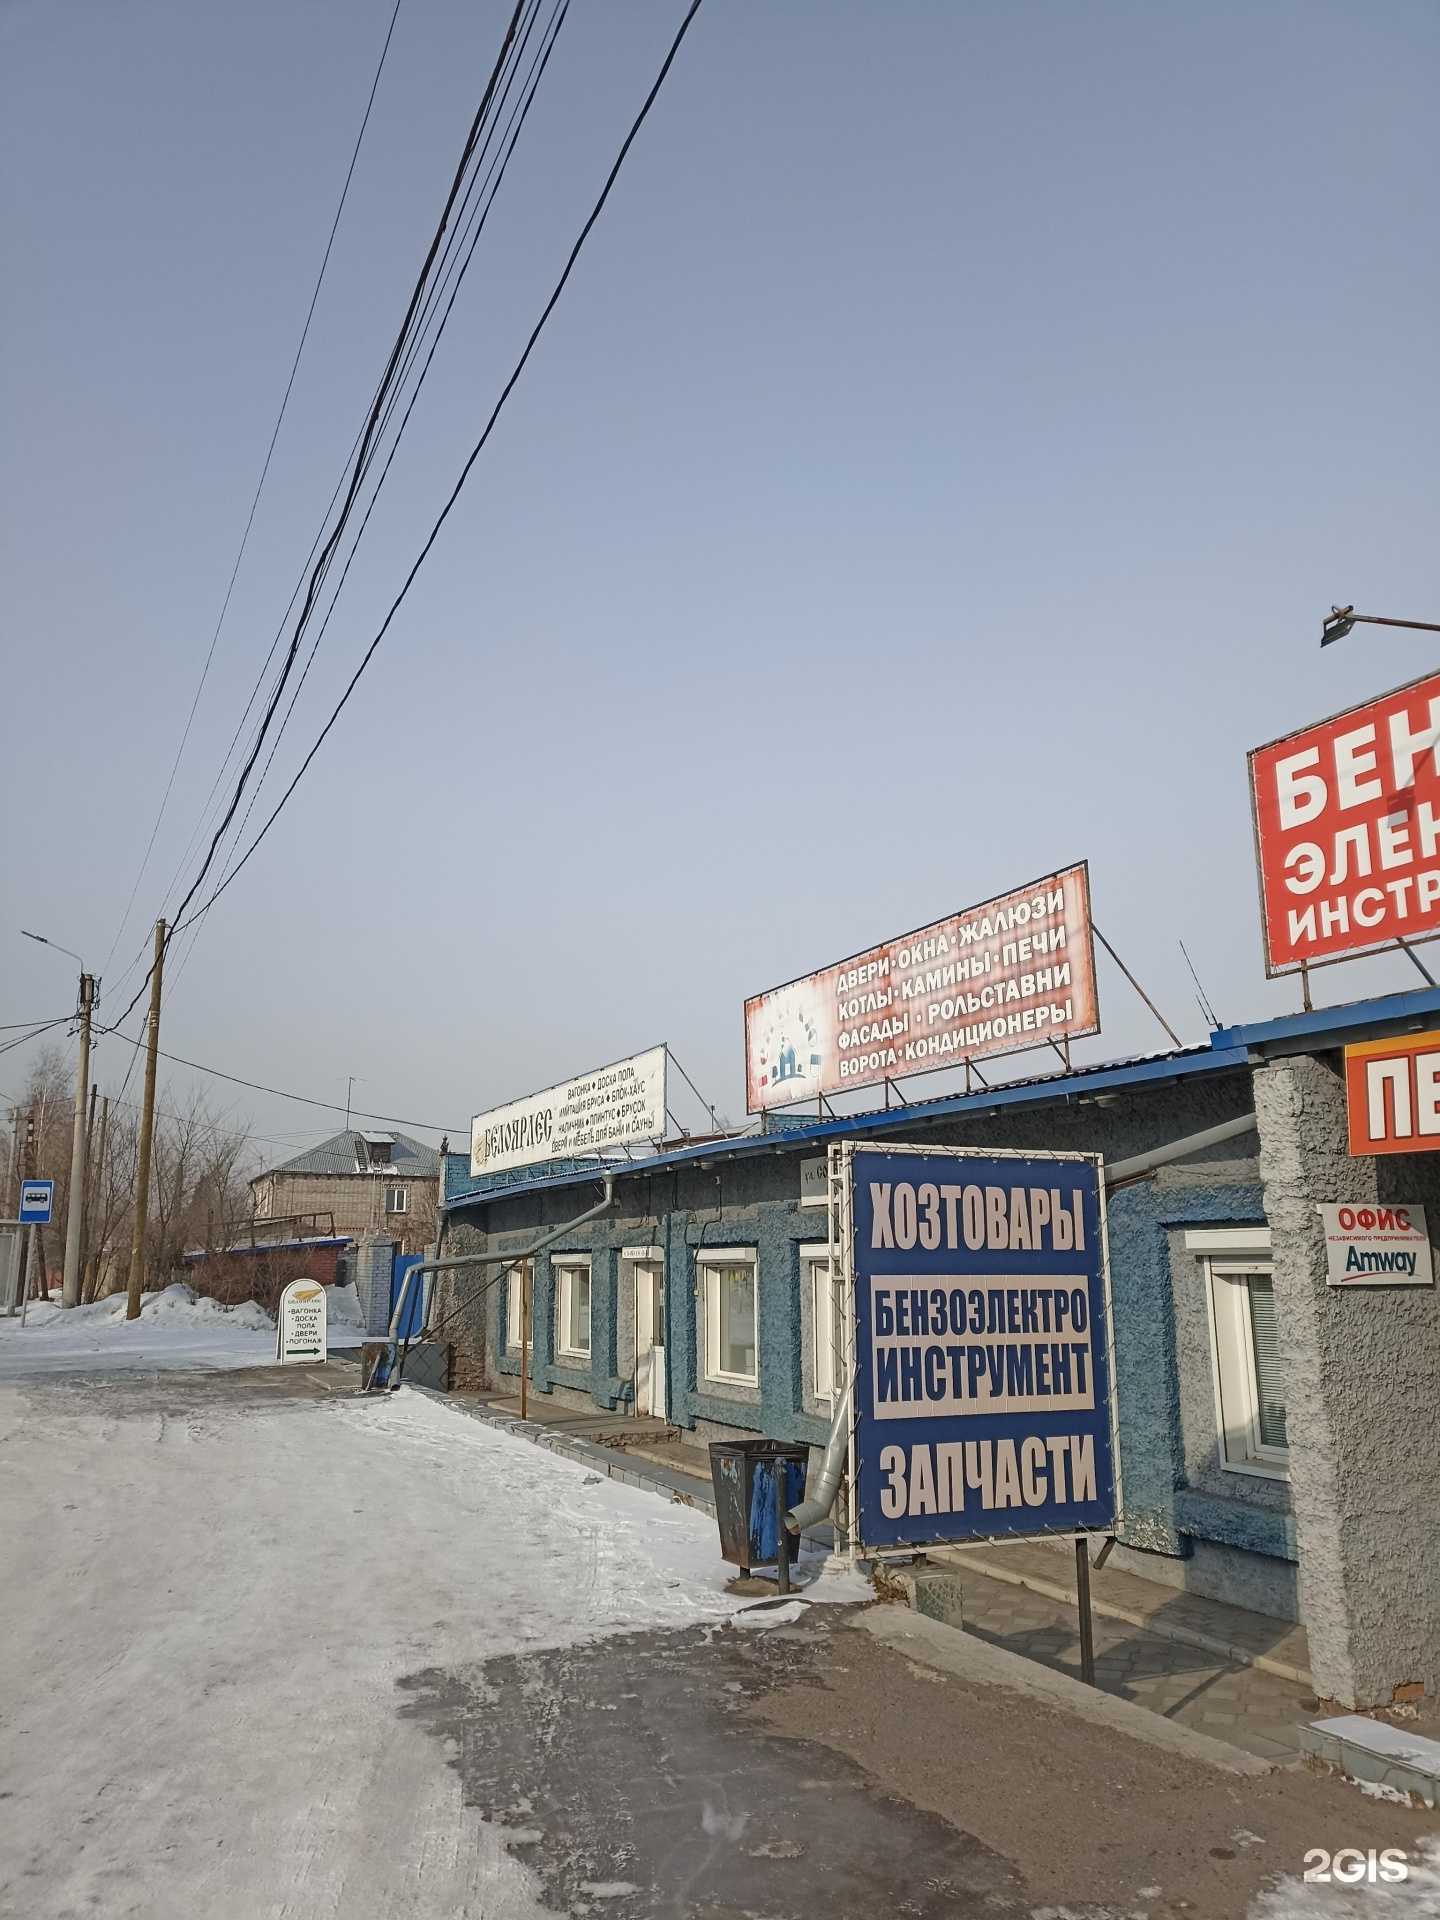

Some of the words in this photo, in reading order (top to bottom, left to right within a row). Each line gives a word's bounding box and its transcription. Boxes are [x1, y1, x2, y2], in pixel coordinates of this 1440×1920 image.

[836, 956, 890, 995] ДВЕРИ
[898, 936, 949, 969] ОКНА
[958, 888, 1065, 947] ЖАЛЮЗИ
[838, 987, 893, 1021] КОТЛЫ
[902, 952, 991, 1000] КАМИНЫ
[1002, 926, 1067, 967] ПЕЧИ
[838, 1012, 909, 1050] ФАСАДЫ
[928, 963, 1071, 1025] РОЛЬСТАВНИ
[839, 1049, 898, 1078] ВОРОТА
[905, 1000, 1073, 1061] КОНДИЦИОНЕРЫ
[568, 1082, 590, 1100] ВАГОНКА
[598, 1073, 617, 1090] ДОСКА
[618, 1067, 635, 1082] ПОЛА
[587, 1095, 605, 1110] БРУСА
[612, 1081, 646, 1102] БЛОК-ХАУС
[589, 1109, 616, 1125] ПЛИНТУС
[621, 1100, 646, 1117] БРУСОК
[596, 1127, 608, 1142] ДЛЯ
[608, 1123, 625, 1139] БАНИ
[632, 1114, 655, 1133] САУНЫ
[870, 1182, 1086, 1251] ХОЗТОВАРЫ
[1338, 1207, 1411, 1231] ОФИС
[1346, 1245, 1417, 1276] Amway
[874, 1288, 1087, 1337] БЕНЗОЭЛЕКТРО
[876, 1342, 1089, 1402] ИНСТРУМЕНТ
[879, 1434, 1097, 1519] ЗАПЧАСТИ
